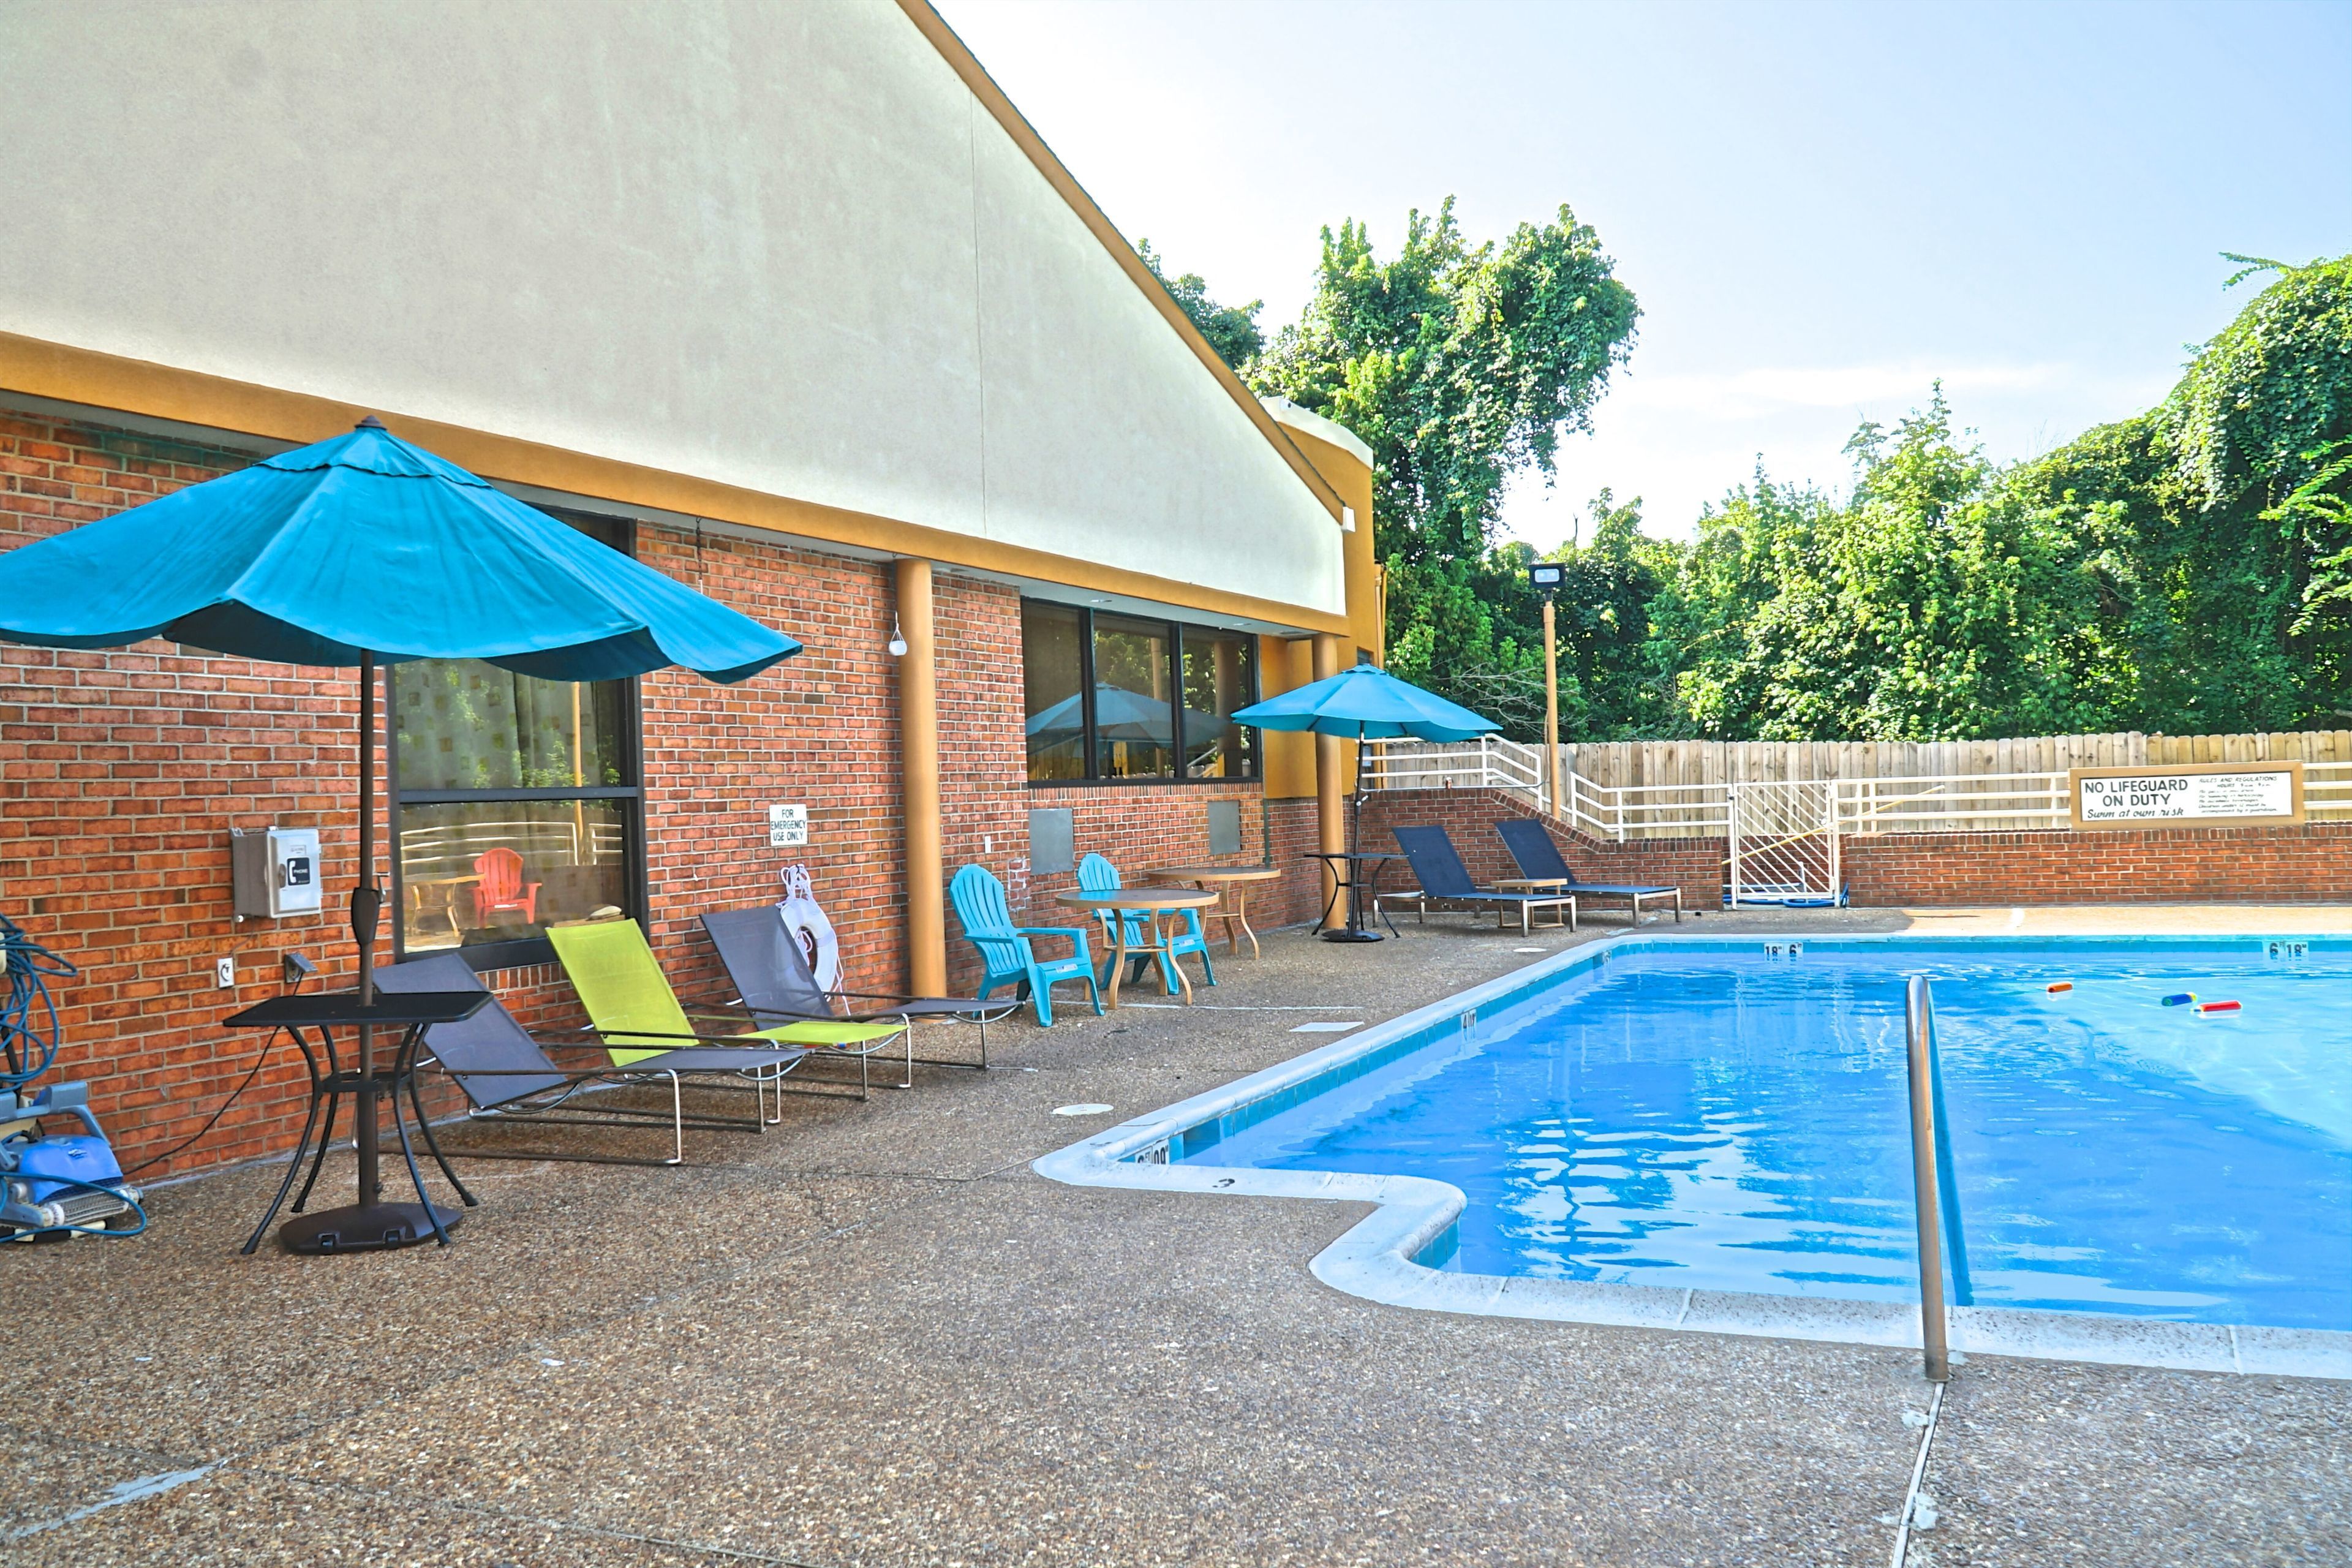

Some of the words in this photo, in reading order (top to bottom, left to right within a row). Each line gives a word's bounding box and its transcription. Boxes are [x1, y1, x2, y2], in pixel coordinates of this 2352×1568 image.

[2085, 782, 2104, 793] NO
[2111, 779, 2188, 793] LIFEGUARD
[2103, 795, 2123, 807] ON
[2130, 793, 2171, 805] DUTY
[782, 809, 794, 818] FOR
[2087, 809, 2114, 818] Swim
[2119, 809, 2130, 817] at
[2158, 807, 2184, 816] risk
[771, 820, 807, 831] EMERGENCY
[773, 831, 785, 841] USE
[786, 831, 804, 840] ONLY
